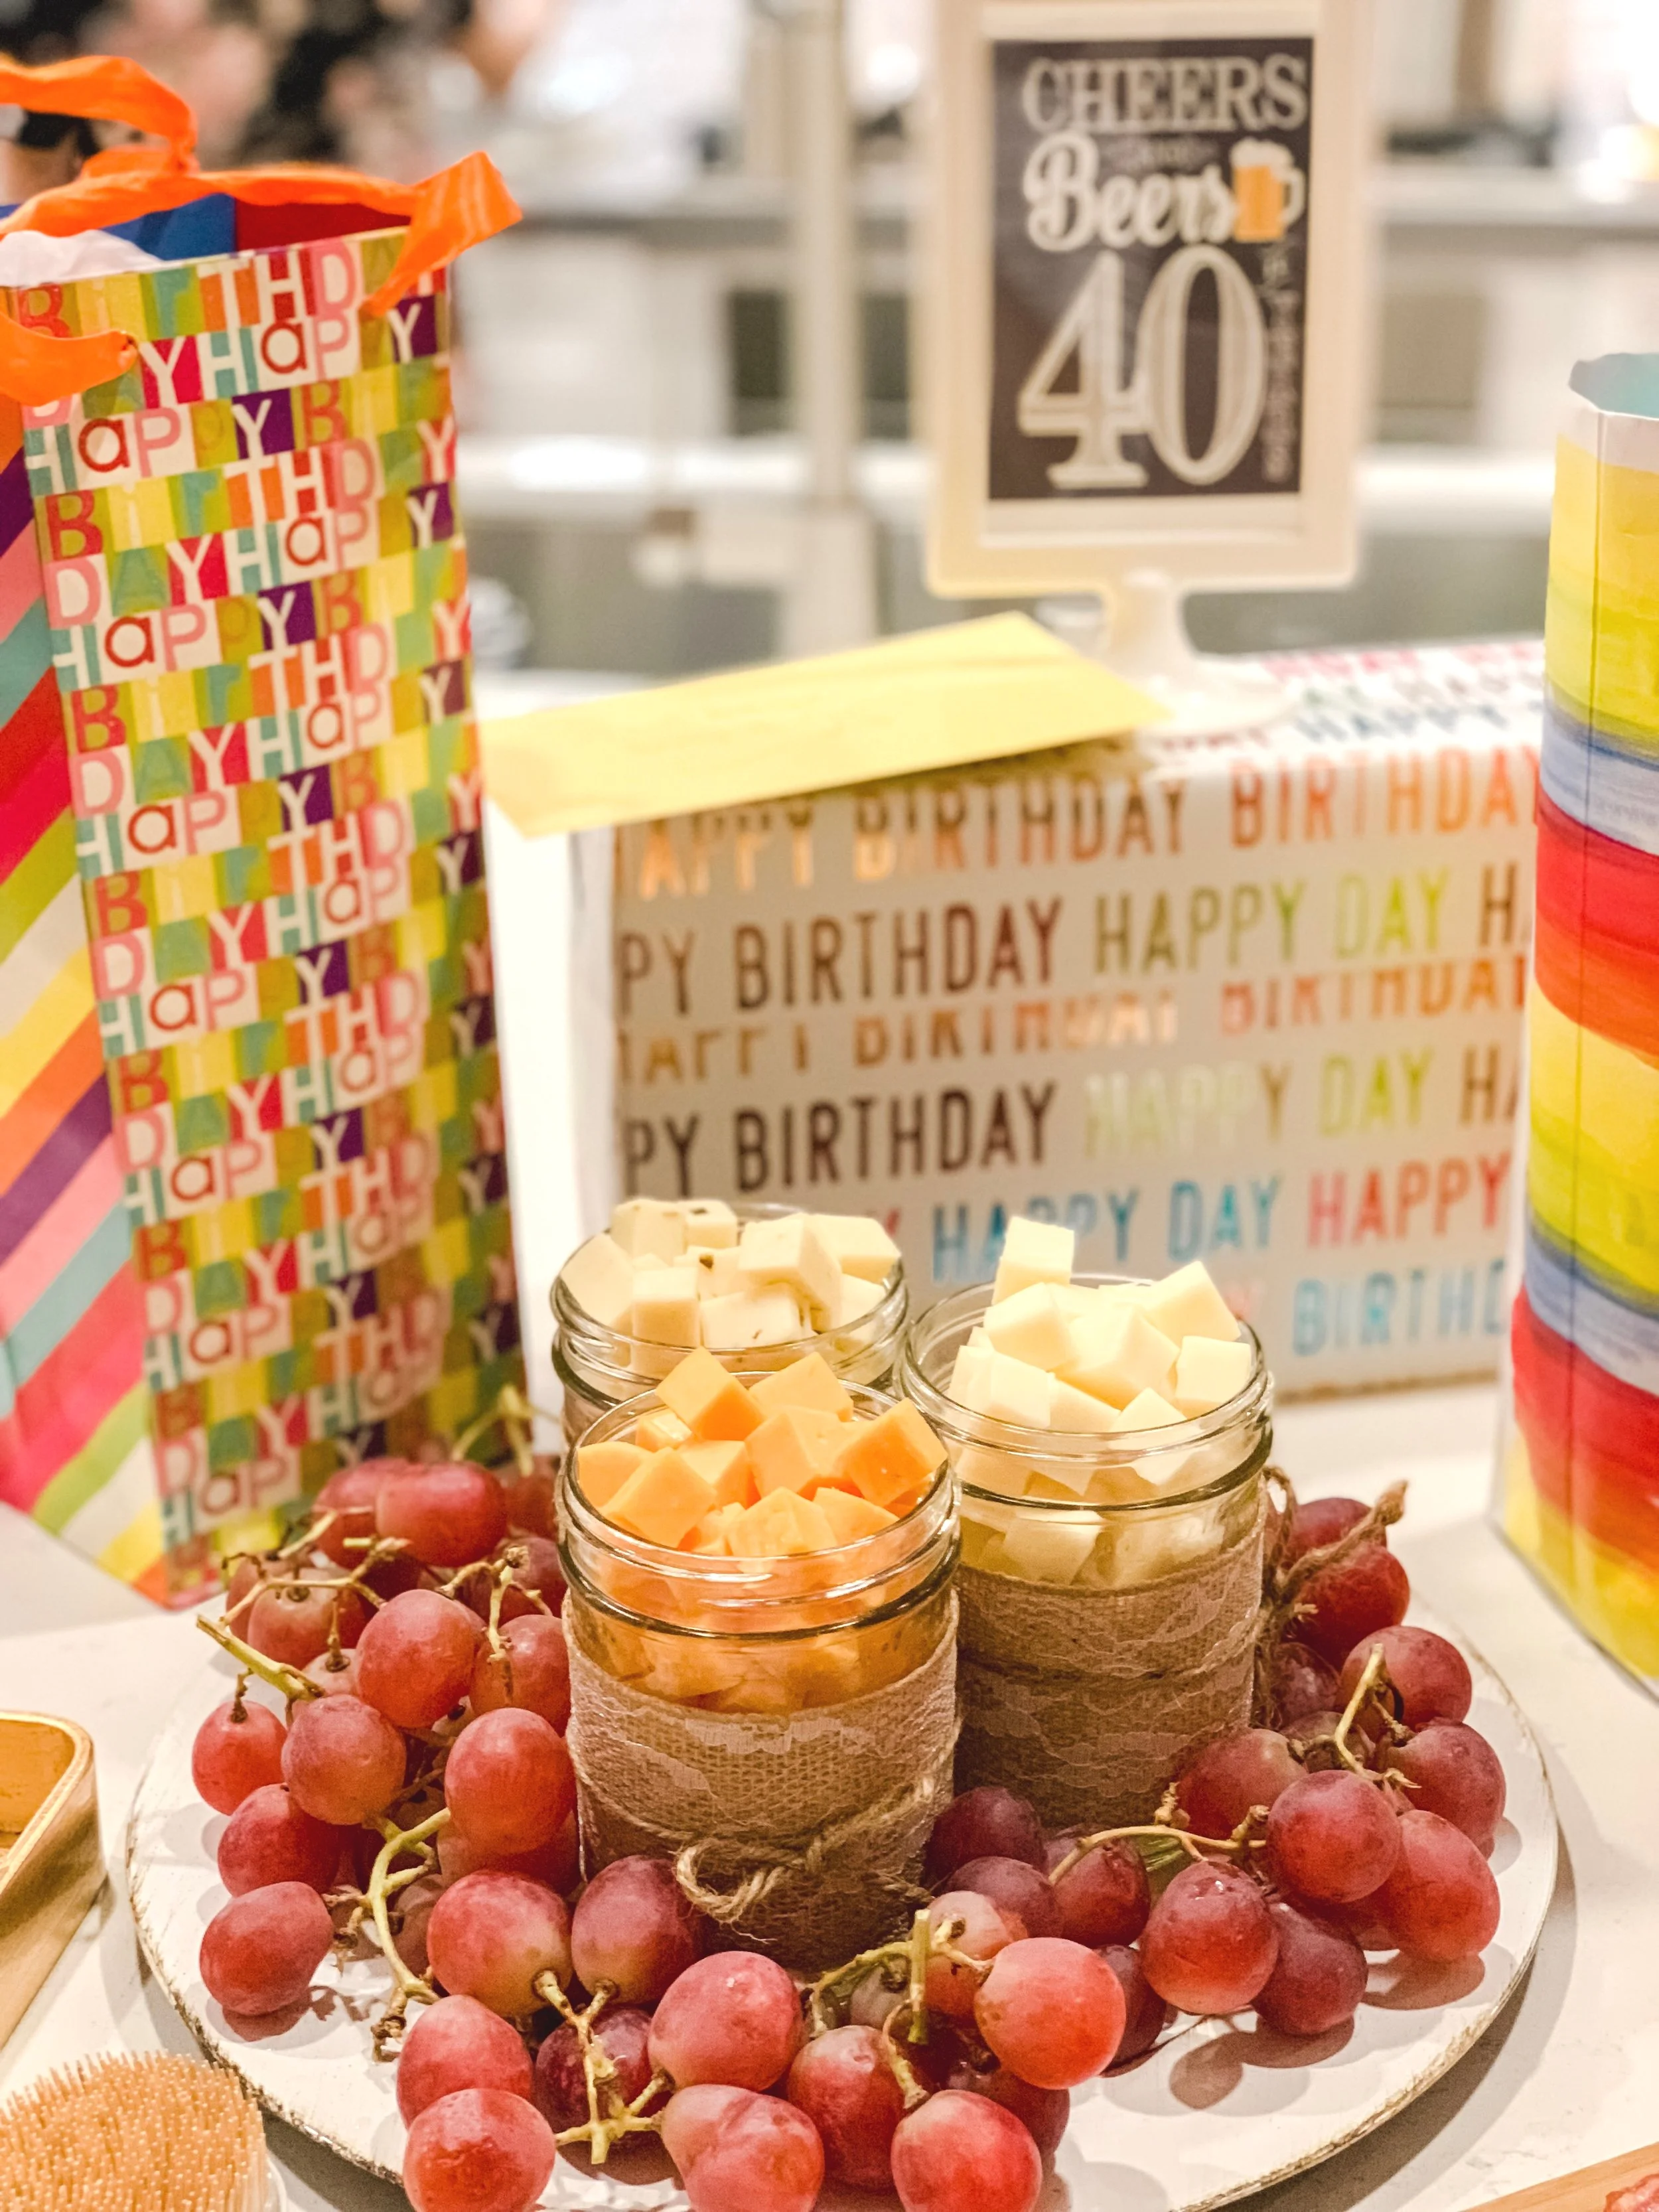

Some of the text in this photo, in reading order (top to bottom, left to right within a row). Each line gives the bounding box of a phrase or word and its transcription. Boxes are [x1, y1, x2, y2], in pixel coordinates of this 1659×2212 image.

[1023, 53, 1307, 132] CHEERS
[1023, 131, 1238, 252] Beers
[1018, 243, 1268, 490] 40
[853, 770, 1189, 881] BIRTHDAY
[733, 894, 1064, 1013] BIRTHDAY
[1094, 876, 1308, 976] HAPPY
[1335, 865, 1451, 959] DAY
[1480, 860, 1531, 949] H
[733, 1076, 1060, 1192] BIRTHDAY
[1084, 1060, 1293, 1159] HAPPY
[1319, 1046, 1435, 1138] DAY
[1169, 1170, 1285, 1262] DAY
[1307, 1149, 1511, 1249] HAPPY
